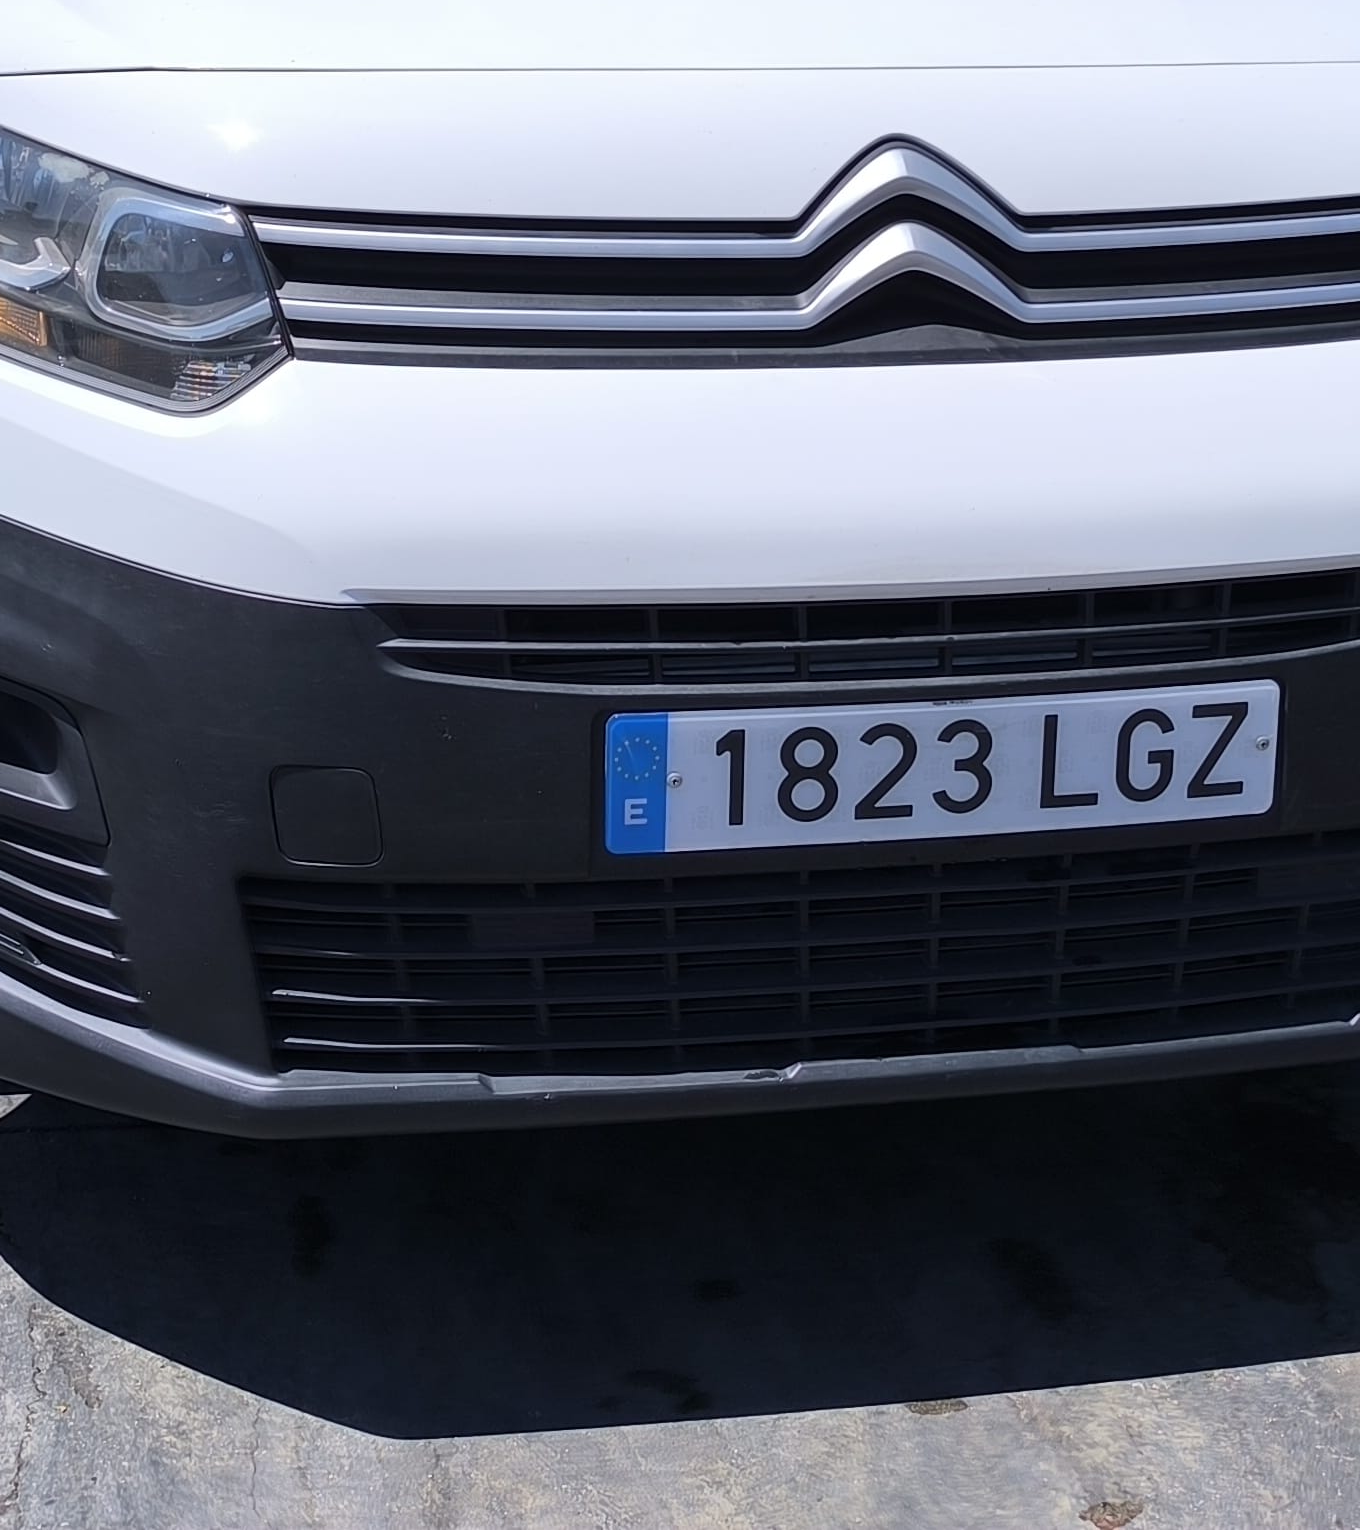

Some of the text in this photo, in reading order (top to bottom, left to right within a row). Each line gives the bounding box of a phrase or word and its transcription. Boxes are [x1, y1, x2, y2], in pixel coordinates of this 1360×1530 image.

[716, 701, 1249, 826] 1823 LGZ
[624, 798, 647, 825] E
